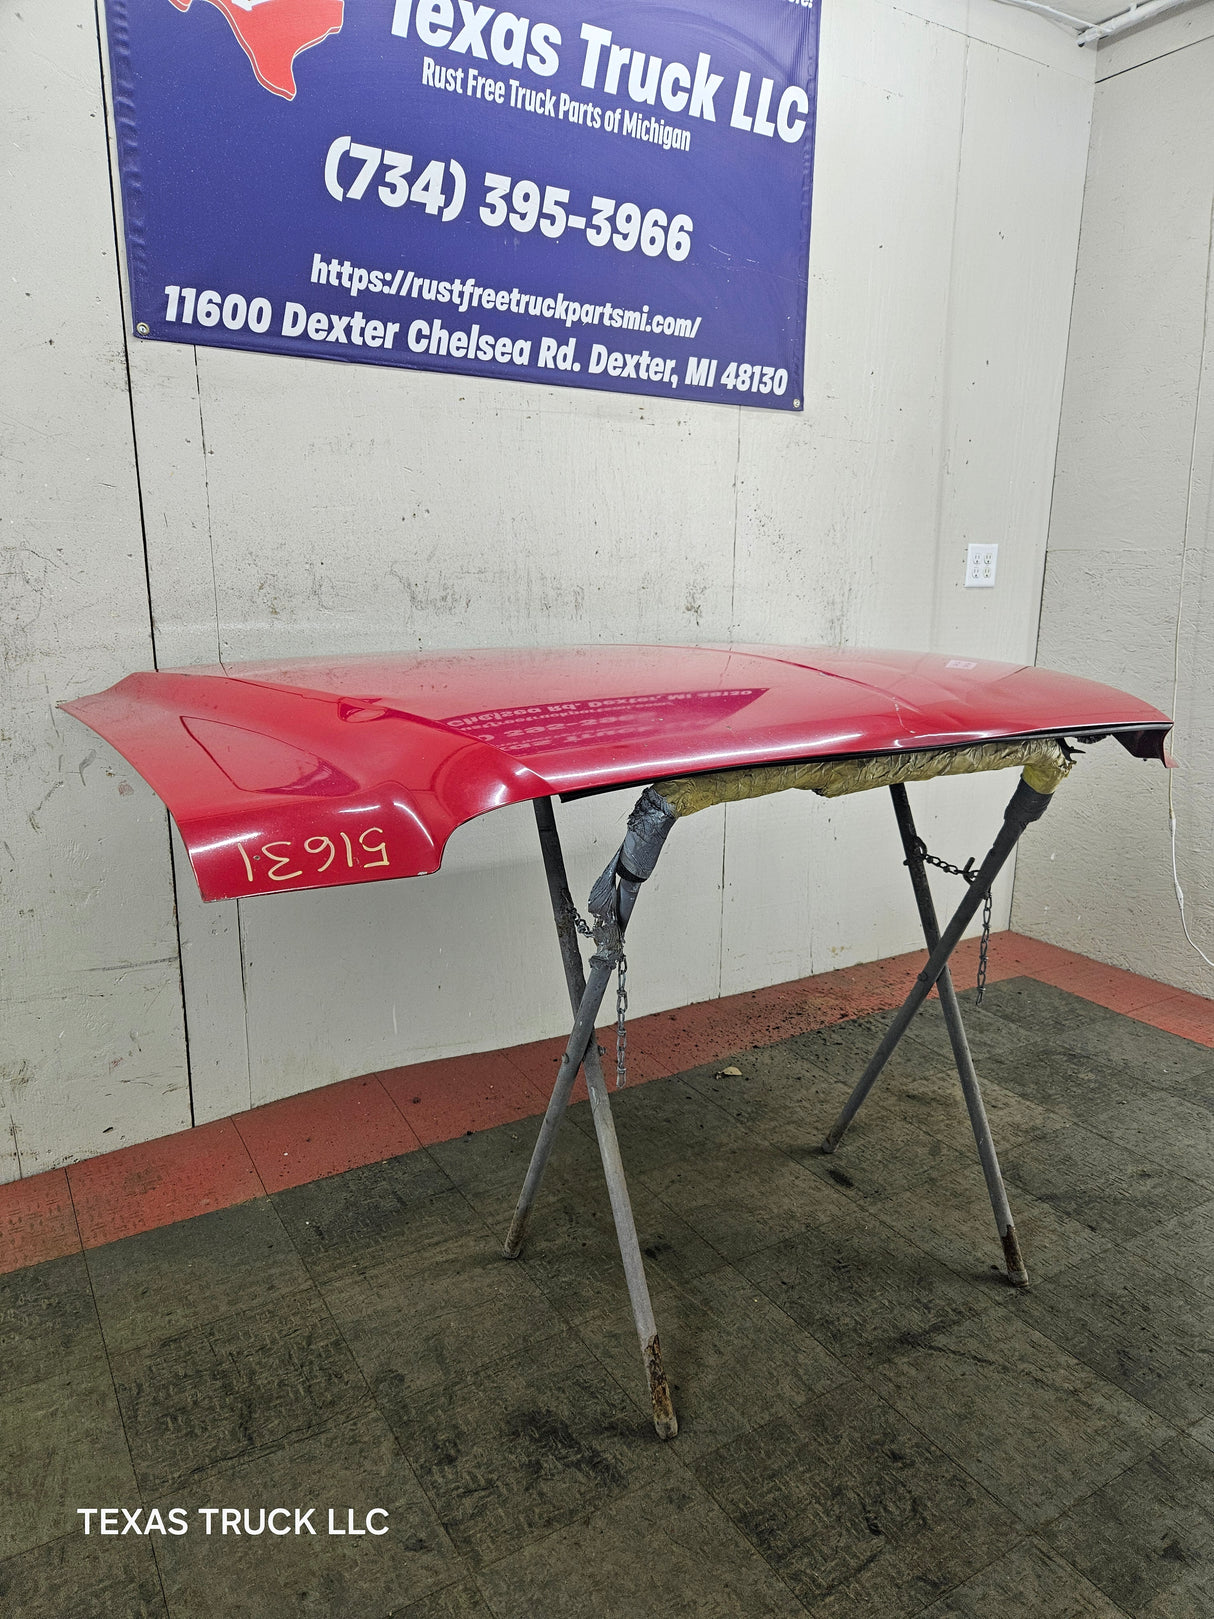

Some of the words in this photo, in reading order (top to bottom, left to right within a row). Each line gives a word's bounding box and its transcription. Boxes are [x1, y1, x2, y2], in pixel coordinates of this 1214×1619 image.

[421, 56, 464, 94] Rust
[466, 67, 505, 103] Free
[509, 78, 557, 118] Truck
[558, 92, 602, 128] Parts
[604, 107, 622, 133] of
[622, 109, 691, 152] Michigan
[580, 22, 725, 123] Truck
[729, 70, 809, 144] LLC
[324, 136, 466, 223] (734)
[480, 172, 694, 262] 395-3966
[164, 285, 272, 333] 11600
[282, 302, 401, 350] Dexter
[408, 319, 531, 366] Chelsea
[537, 336, 581, 373] Rd.
[588, 343, 679, 389] Dexter,
[684, 356, 718, 388] MI
[720, 361, 789, 396] 48130
[310, 252, 702, 339] https://rustfreetruckpartsmi.com/
[237, 827, 390, 882] 51631
